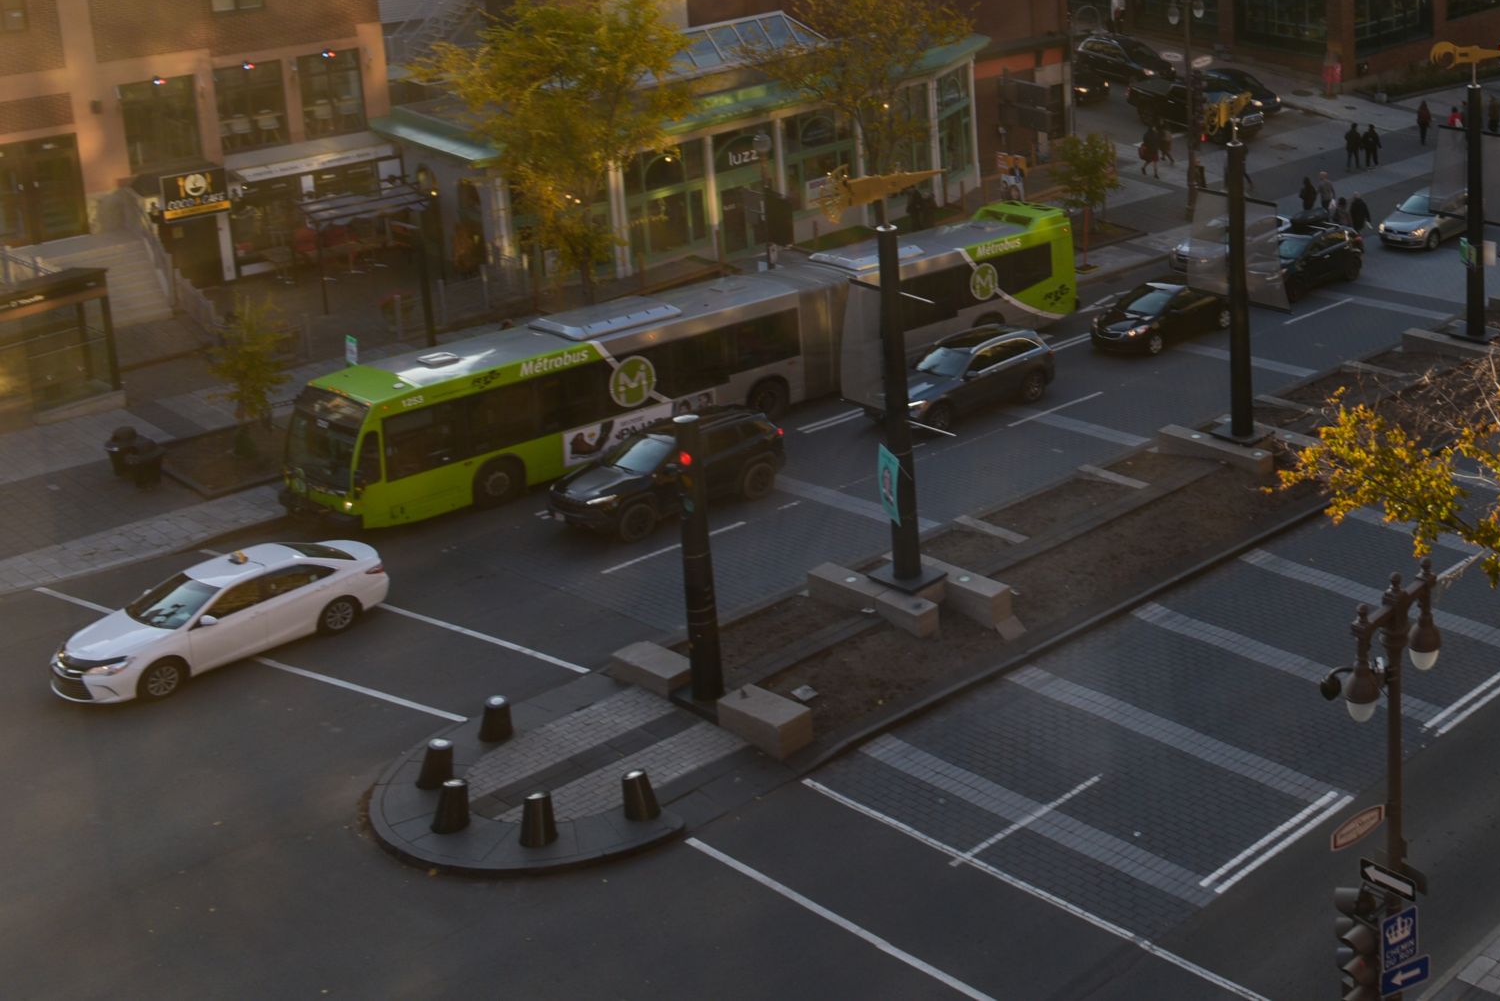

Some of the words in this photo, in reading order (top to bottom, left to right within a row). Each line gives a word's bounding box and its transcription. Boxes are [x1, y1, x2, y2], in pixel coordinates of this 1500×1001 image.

[728, 149, 760, 167] luzz
[976, 238, 1022, 257] Métrobus
[519, 349, 590, 377] Métrobus
